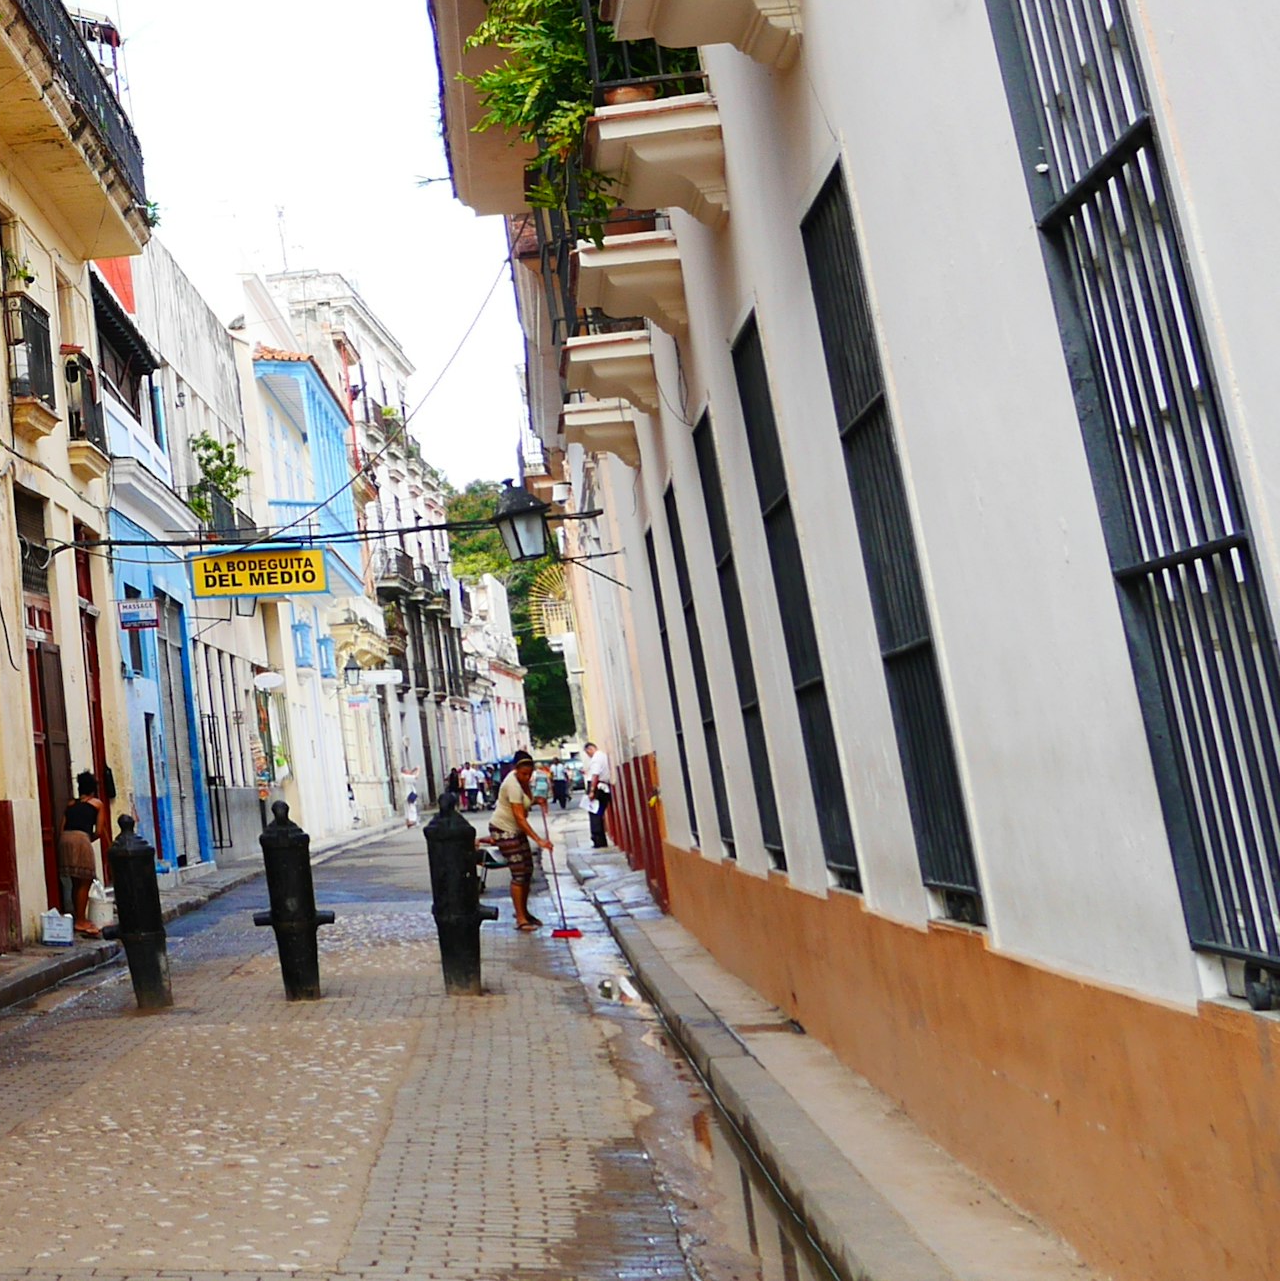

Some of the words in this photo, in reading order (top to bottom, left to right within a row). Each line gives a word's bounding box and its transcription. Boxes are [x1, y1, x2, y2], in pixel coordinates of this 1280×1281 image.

[203, 561, 222, 574] LA
[226, 557, 314, 572] BODEGUITA
[204, 573, 243, 588] DEL
[249, 570, 316, 586] MEDIO
